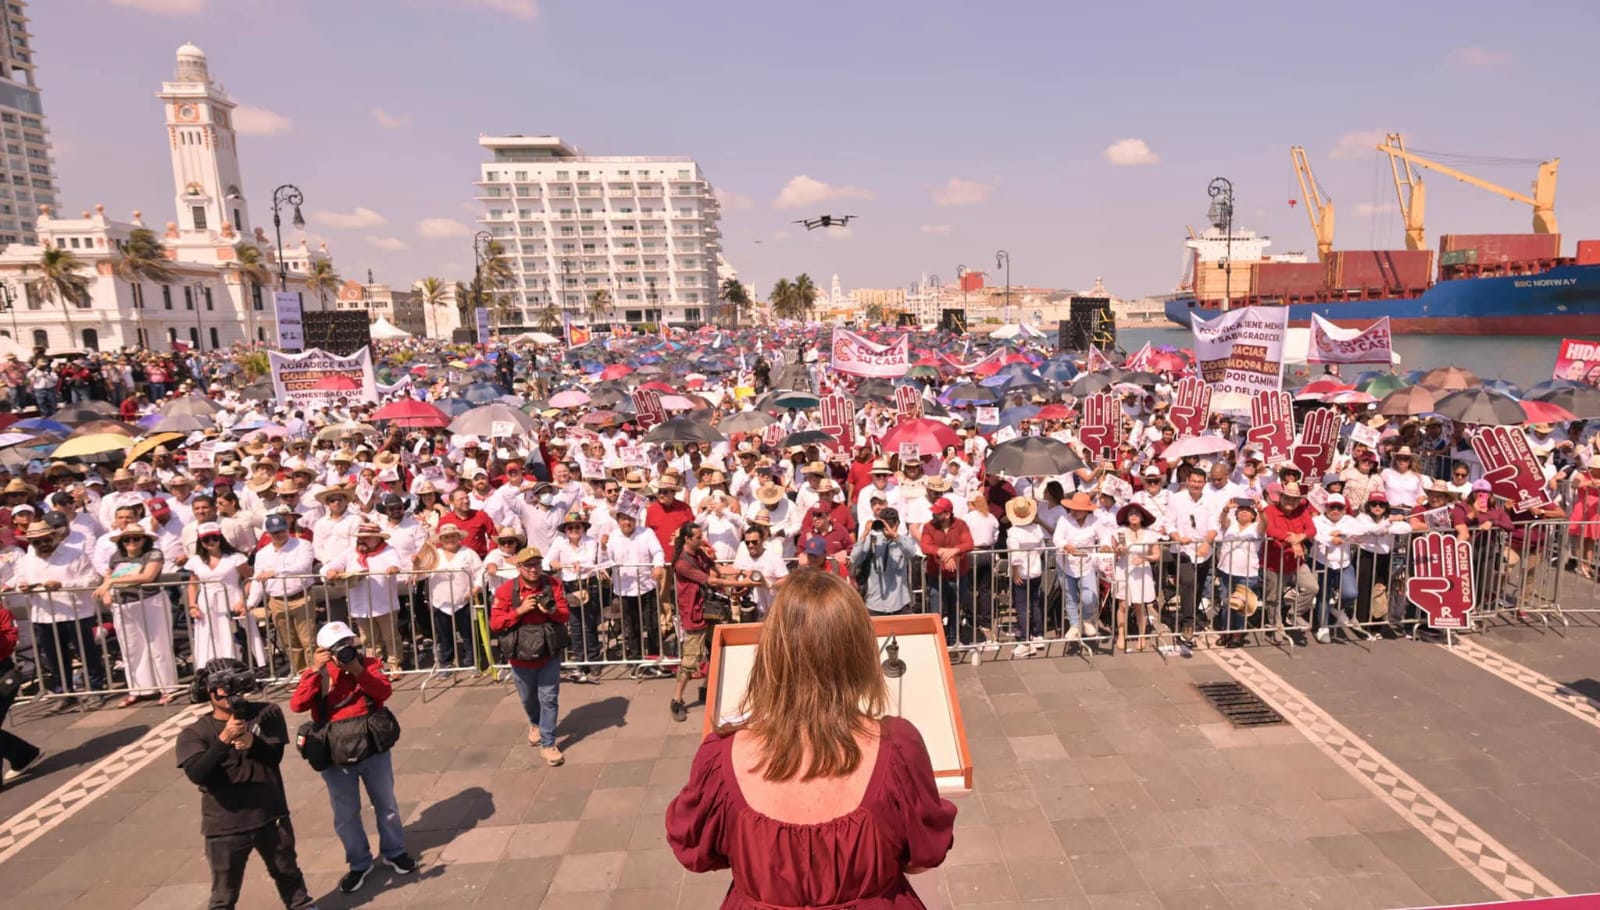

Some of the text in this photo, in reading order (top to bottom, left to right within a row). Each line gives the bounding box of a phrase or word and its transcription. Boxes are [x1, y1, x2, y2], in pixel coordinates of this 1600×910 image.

[1533, 278, 1577, 287] NORWAY
[280, 360, 360, 370] AGRADECE A LA
[857, 355, 904, 365] SU CASA
[1226, 371, 1247, 381] POR
[345, 390, 363, 398] QUE
[1499, 433, 1516, 461] MARCHA
[1511, 429, 1529, 454] RICA
[1523, 453, 1543, 481] POZA
[1445, 543, 1453, 576] MARCHA
[1459, 544, 1471, 603] POZA RICA
[1441, 606, 1453, 618] R
